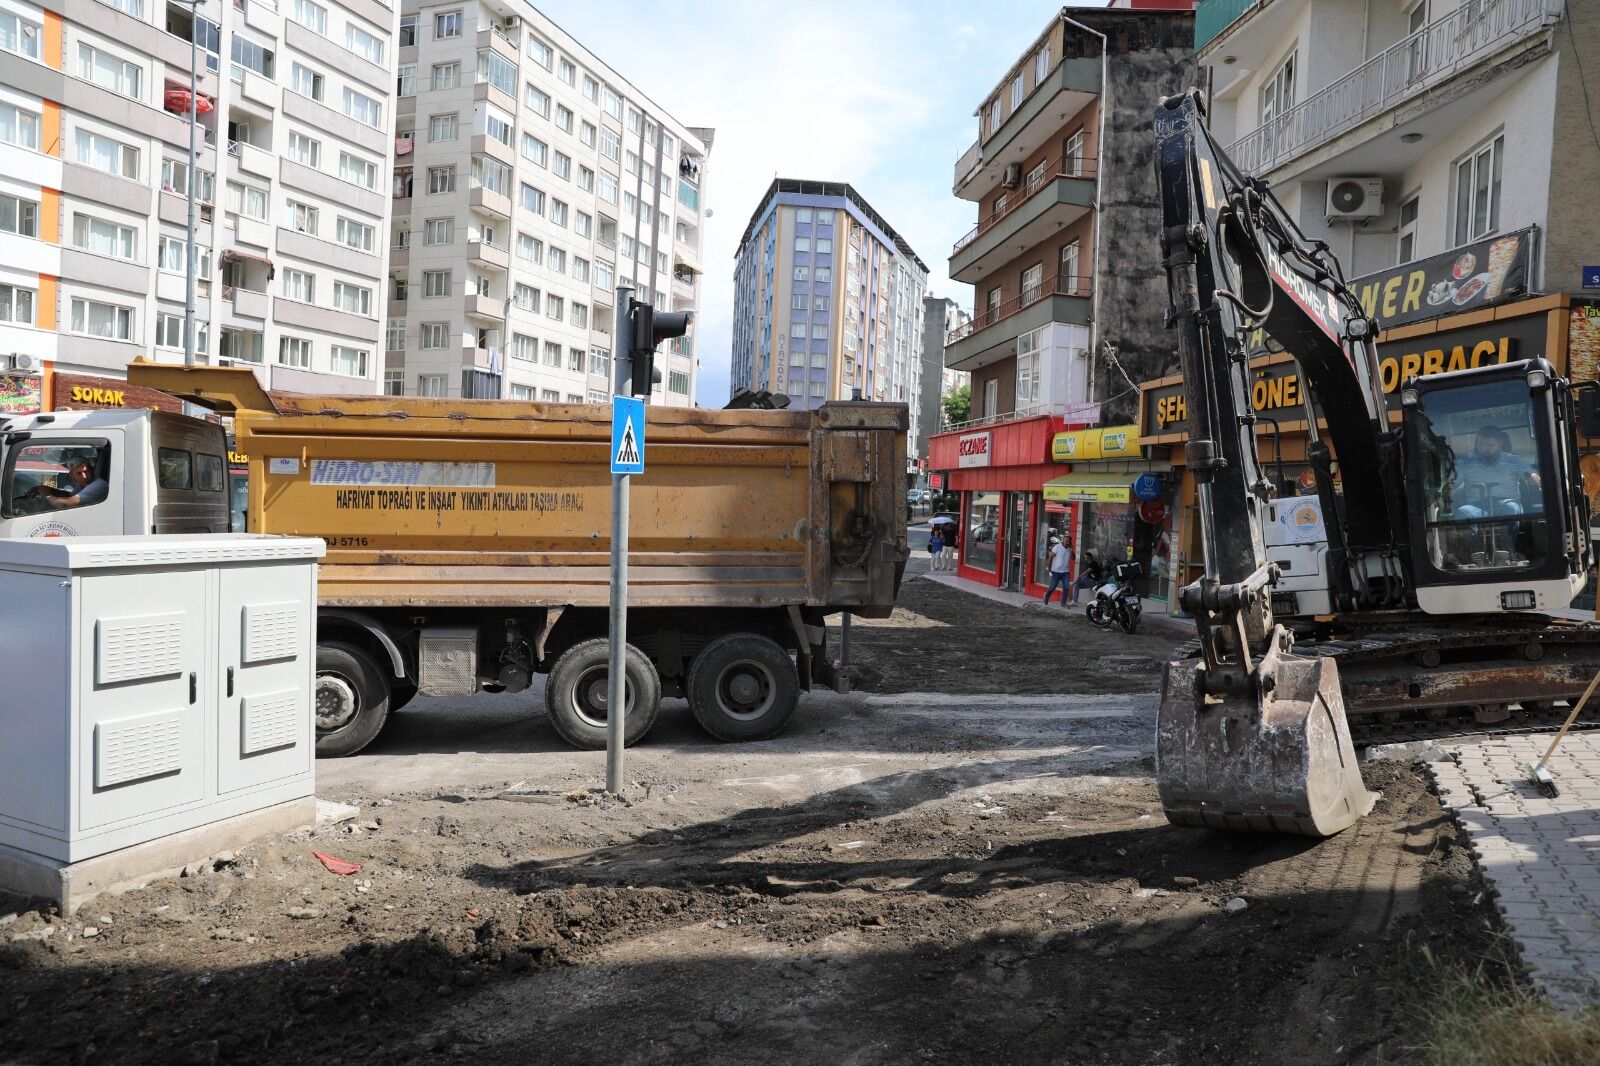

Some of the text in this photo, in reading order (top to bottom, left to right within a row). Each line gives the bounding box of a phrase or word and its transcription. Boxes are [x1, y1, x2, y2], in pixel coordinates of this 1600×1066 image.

[1347, 270, 1425, 320] NER
[1156, 337, 1510, 430] ŞEH ÖNE ORBACI
[71, 386, 125, 405] SOKAK
[960, 436, 988, 456] ECZANE
[228, 450, 250, 464] KEB
[415, 491, 426, 510] VE
[341, 537, 369, 546] 5716
